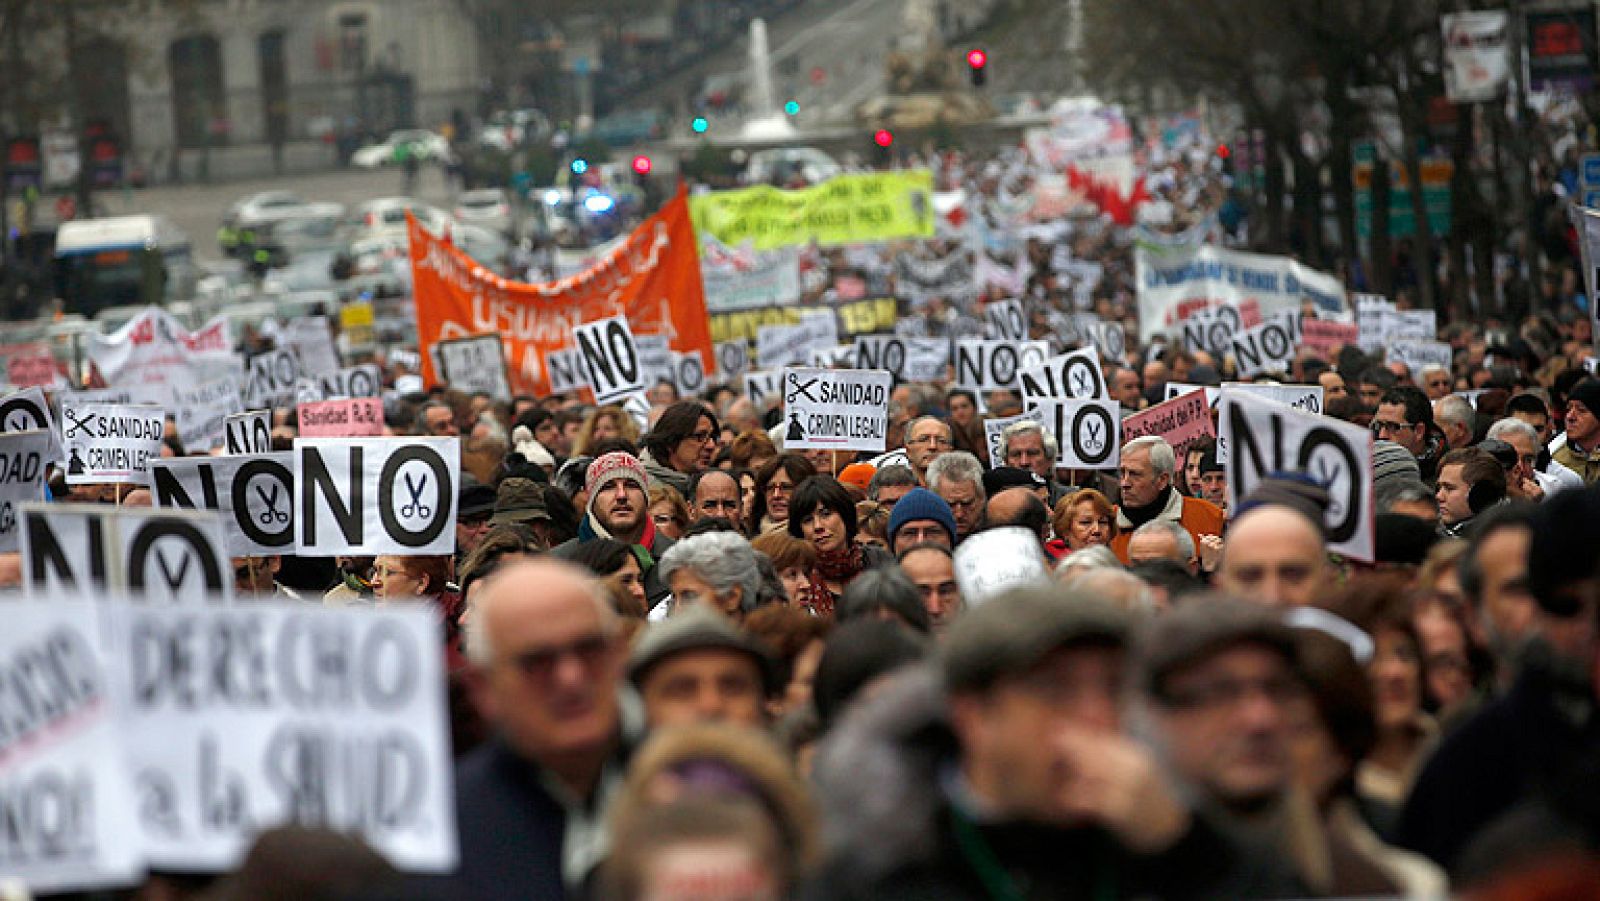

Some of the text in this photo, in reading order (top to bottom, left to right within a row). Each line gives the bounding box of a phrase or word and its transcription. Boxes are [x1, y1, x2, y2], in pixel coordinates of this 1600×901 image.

[252, 351, 296, 392] NO
[577, 319, 637, 392] NO
[857, 338, 905, 374] NO
[959, 345, 1018, 386] NO
[820, 381, 886, 408] SANIDAD,
[1020, 355, 1101, 399] NO
[98, 416, 161, 441] SANIDAD
[226, 416, 270, 454] NO
[302, 407, 349, 427] Sanidad
[808, 414, 848, 436] CRIMEN
[88, 448, 130, 470] CRIMEN
[1228, 400, 1362, 543] NO
[153, 458, 294, 547] NO
[302, 445, 452, 546] NO
[27, 512, 224, 592] NO
[130, 612, 421, 711] DERECHO
